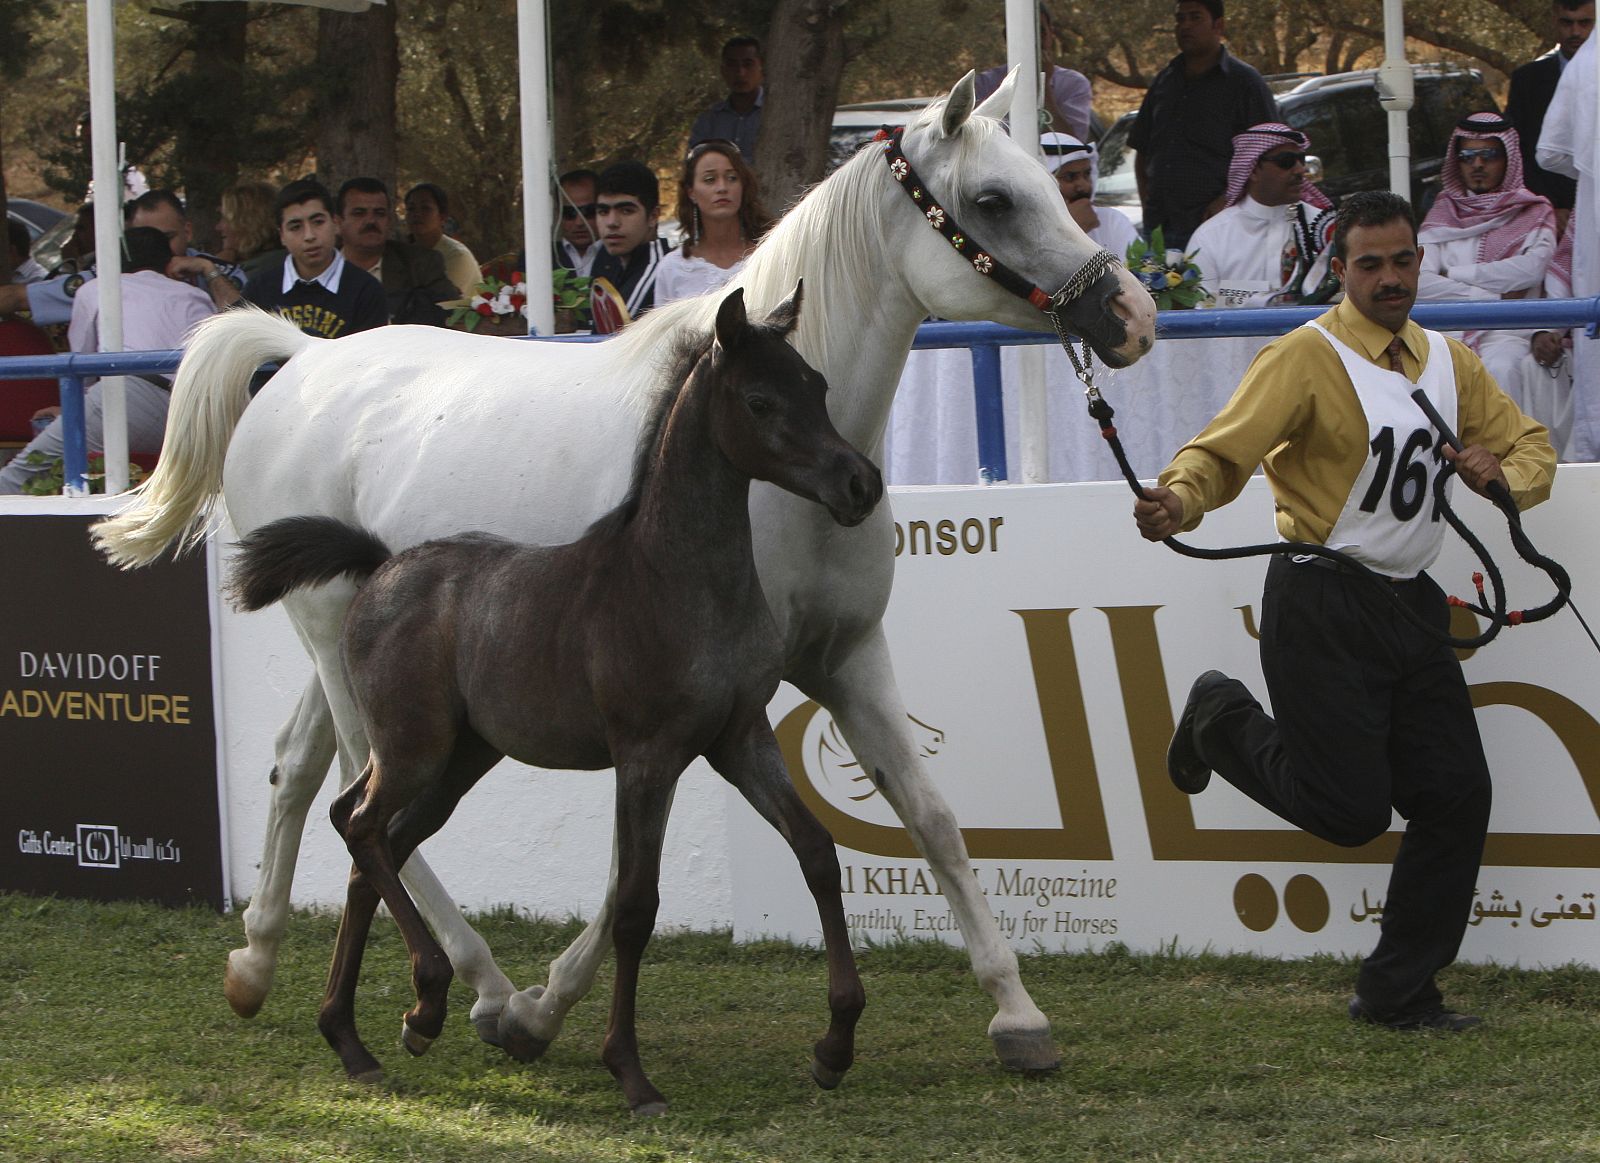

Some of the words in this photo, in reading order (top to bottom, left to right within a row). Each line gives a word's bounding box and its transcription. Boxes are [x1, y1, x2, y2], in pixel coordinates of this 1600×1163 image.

[1218, 288, 1259, 298] RESERV
[19, 651, 161, 681] DAVIDOFF
[0, 690, 190, 724] ADVENTURE
[43, 830, 75, 856] Center
[862, 867, 987, 895] KHA
[994, 867, 1117, 907] Magazine
[842, 908, 907, 937] onthly,
[1020, 910, 1048, 940] for
[1053, 911, 1118, 934] Horses
[1467, 888, 1522, 928] بشؤ
